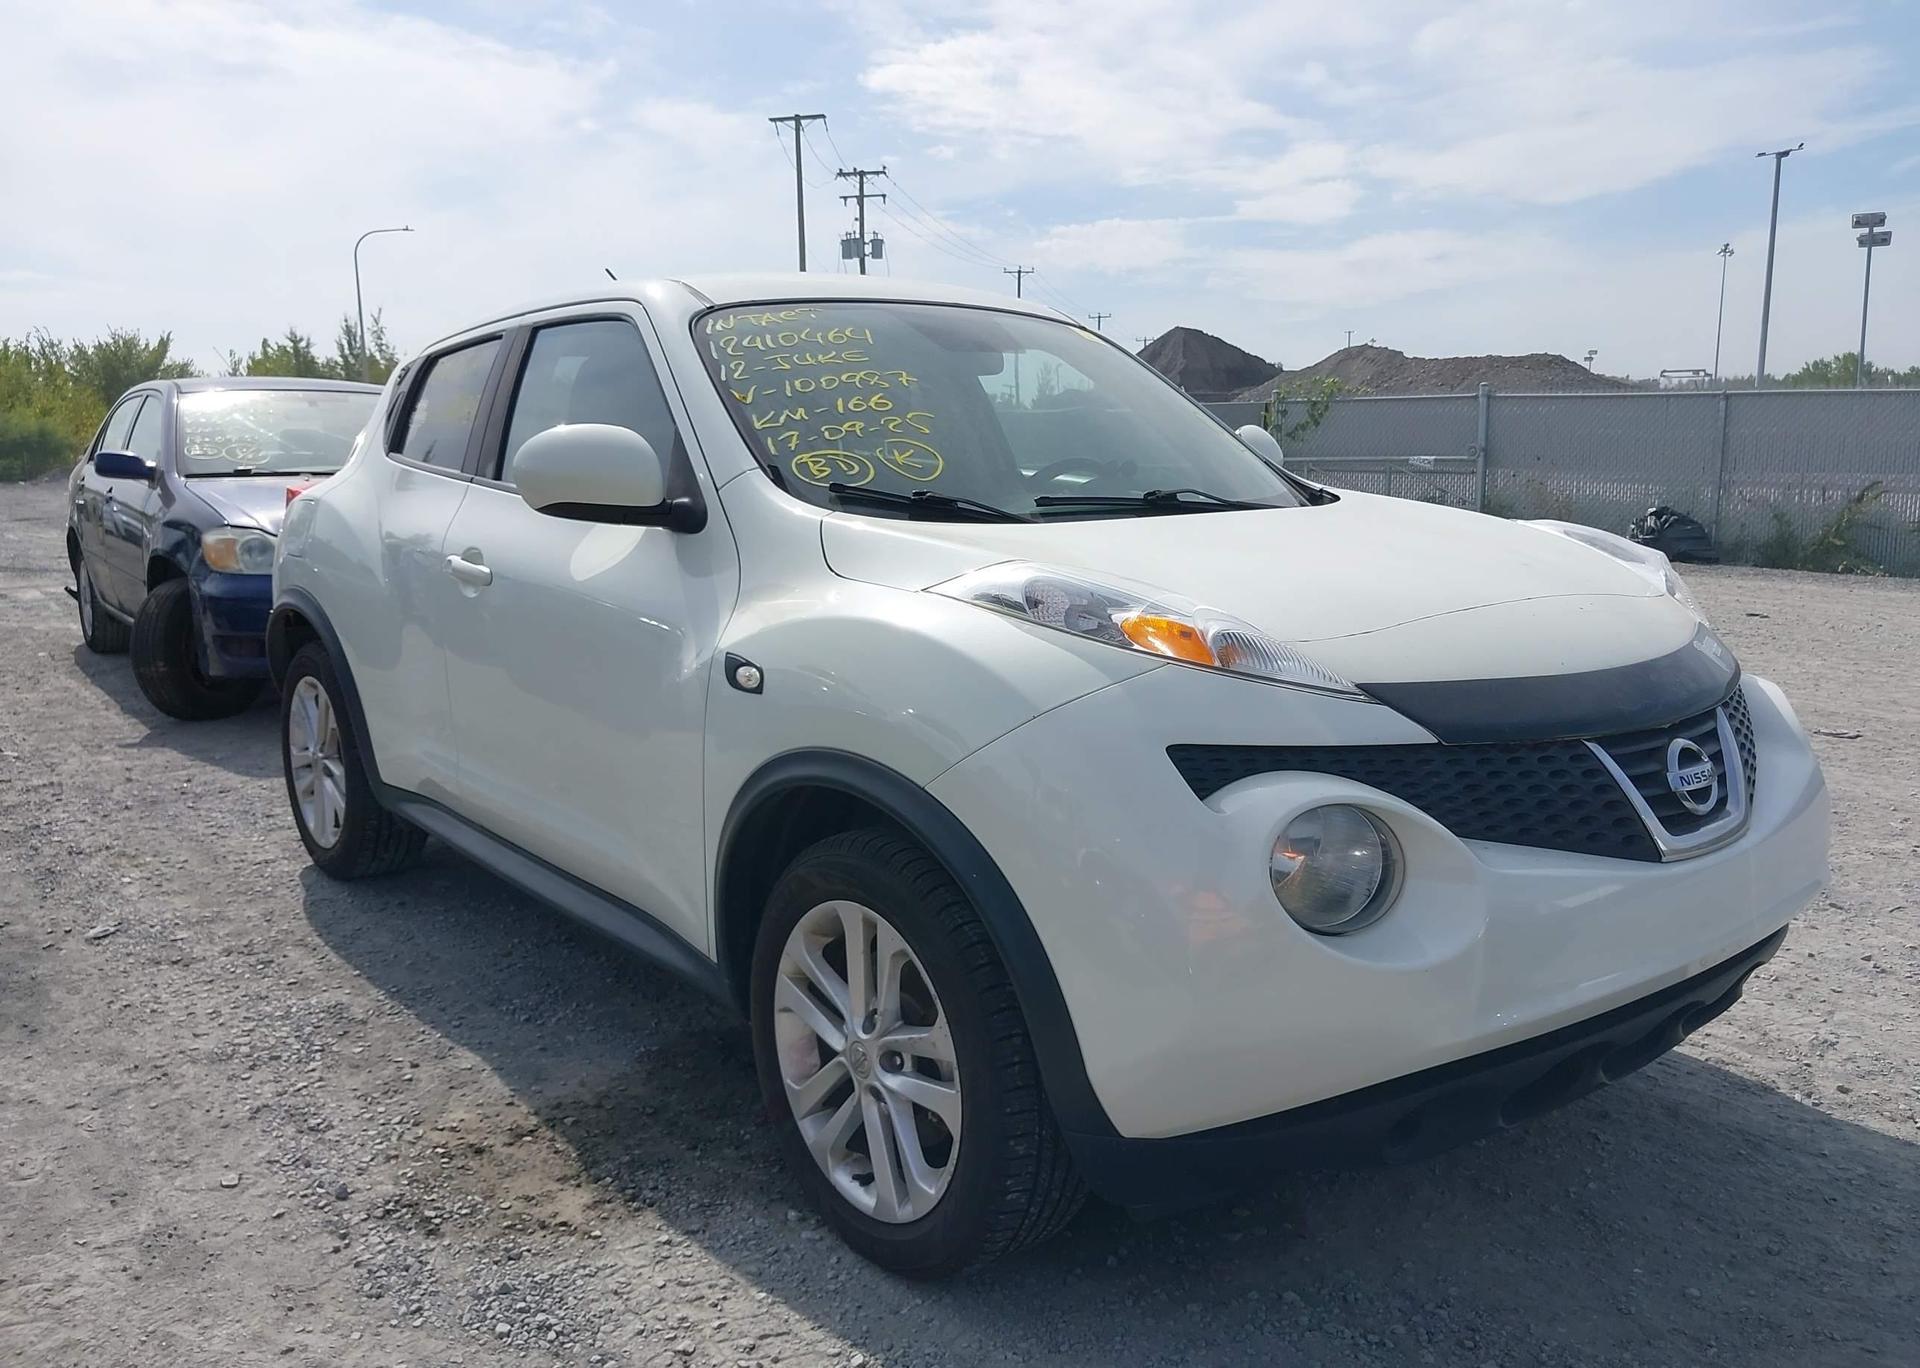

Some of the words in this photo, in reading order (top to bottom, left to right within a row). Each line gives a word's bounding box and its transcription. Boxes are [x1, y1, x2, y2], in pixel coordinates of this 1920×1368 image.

[710, 327, 874, 360] 12410464
[720, 350, 870, 382] 12-JUKE
[752, 392, 894, 430] KM-166
[767, 411, 935, 456] 17-09-25
[1679, 767, 1714, 787] NISSA
